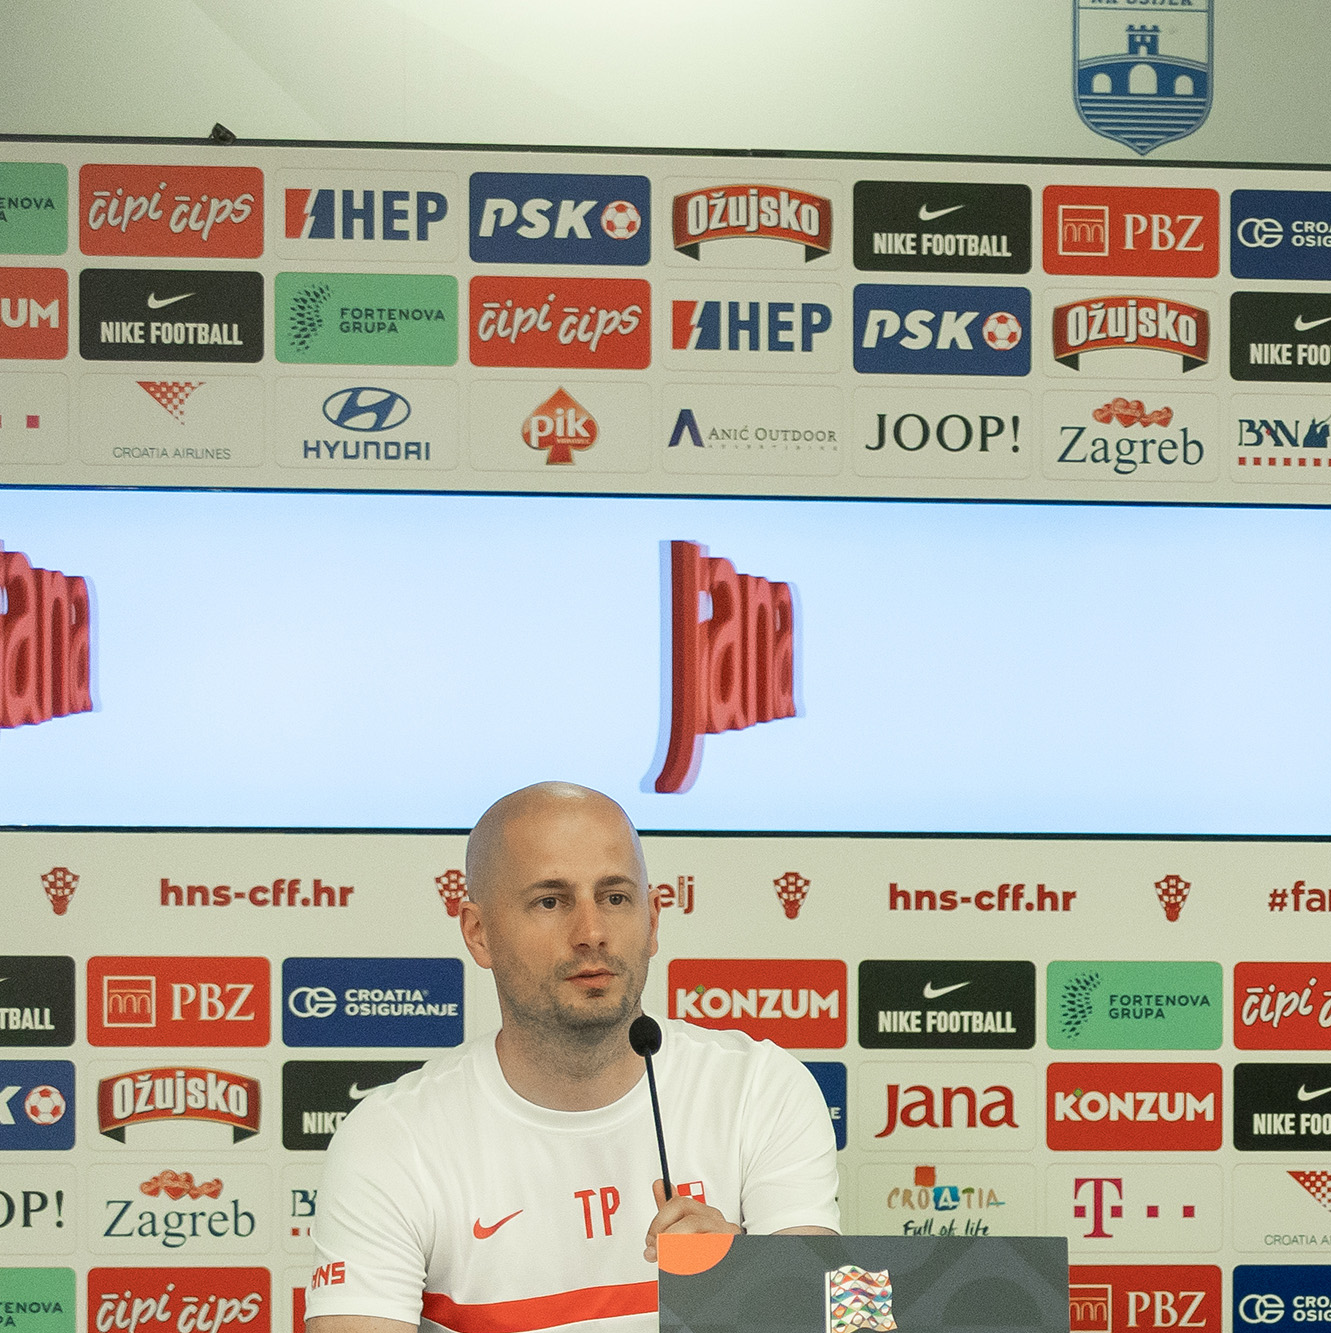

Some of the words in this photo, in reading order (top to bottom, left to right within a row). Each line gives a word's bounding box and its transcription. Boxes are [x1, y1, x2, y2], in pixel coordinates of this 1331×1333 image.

[342, 190, 448, 241] HEP
[479, 199, 597, 239] PSK
[687, 190, 818, 237] Ožujsko
[873, 233, 917, 255] NIKE
[921, 233, 1012, 257] FOOTBALL
[1124, 214, 1203, 251] PBZ
[339, 321, 398, 333] GRUPA
[340, 308, 445, 321] FORTENOVA
[728, 302, 832, 352] HEP
[862, 310, 979, 349] PSK
[1066, 299, 1197, 346] Ožujsko
[101, 321, 145, 343] NIKE
[150, 322, 243, 345] FOOTBALL
[1250, 343, 1292, 365] NIKE
[530, 407, 590, 447] pik
[865, 414, 1019, 453] JOOP!
[112, 447, 169, 458] CROATIA
[172, 448, 231, 460] AIRLINES
[304, 440, 430, 460] HYUNDAI
[1057, 427, 1204, 475] Zagreb
[161, 878, 354, 907] hns-cff.hr
[889, 883, 1076, 911] hns-cff.hr
[172, 983, 254, 1020] PBZ
[345, 989, 427, 1002] CROATIA
[345, 1003, 458, 1016] OSIGURANJE
[675, 987, 838, 1019] KONZUM
[1110, 995, 1210, 1006] FORTENOVA
[878, 1011, 922, 1033] NIKE
[926, 1011, 1016, 1033] FOOTBALL
[1109, 1008, 1165, 1019] GRUPA
[112, 1070, 249, 1119] Ožujsko
[1055, 1089, 1214, 1121] KONZUM
[103, 1199, 255, 1248] Zagreb
[574, 1186, 620, 1239] TP
[1127, 1291, 1206, 1327] PBZ
